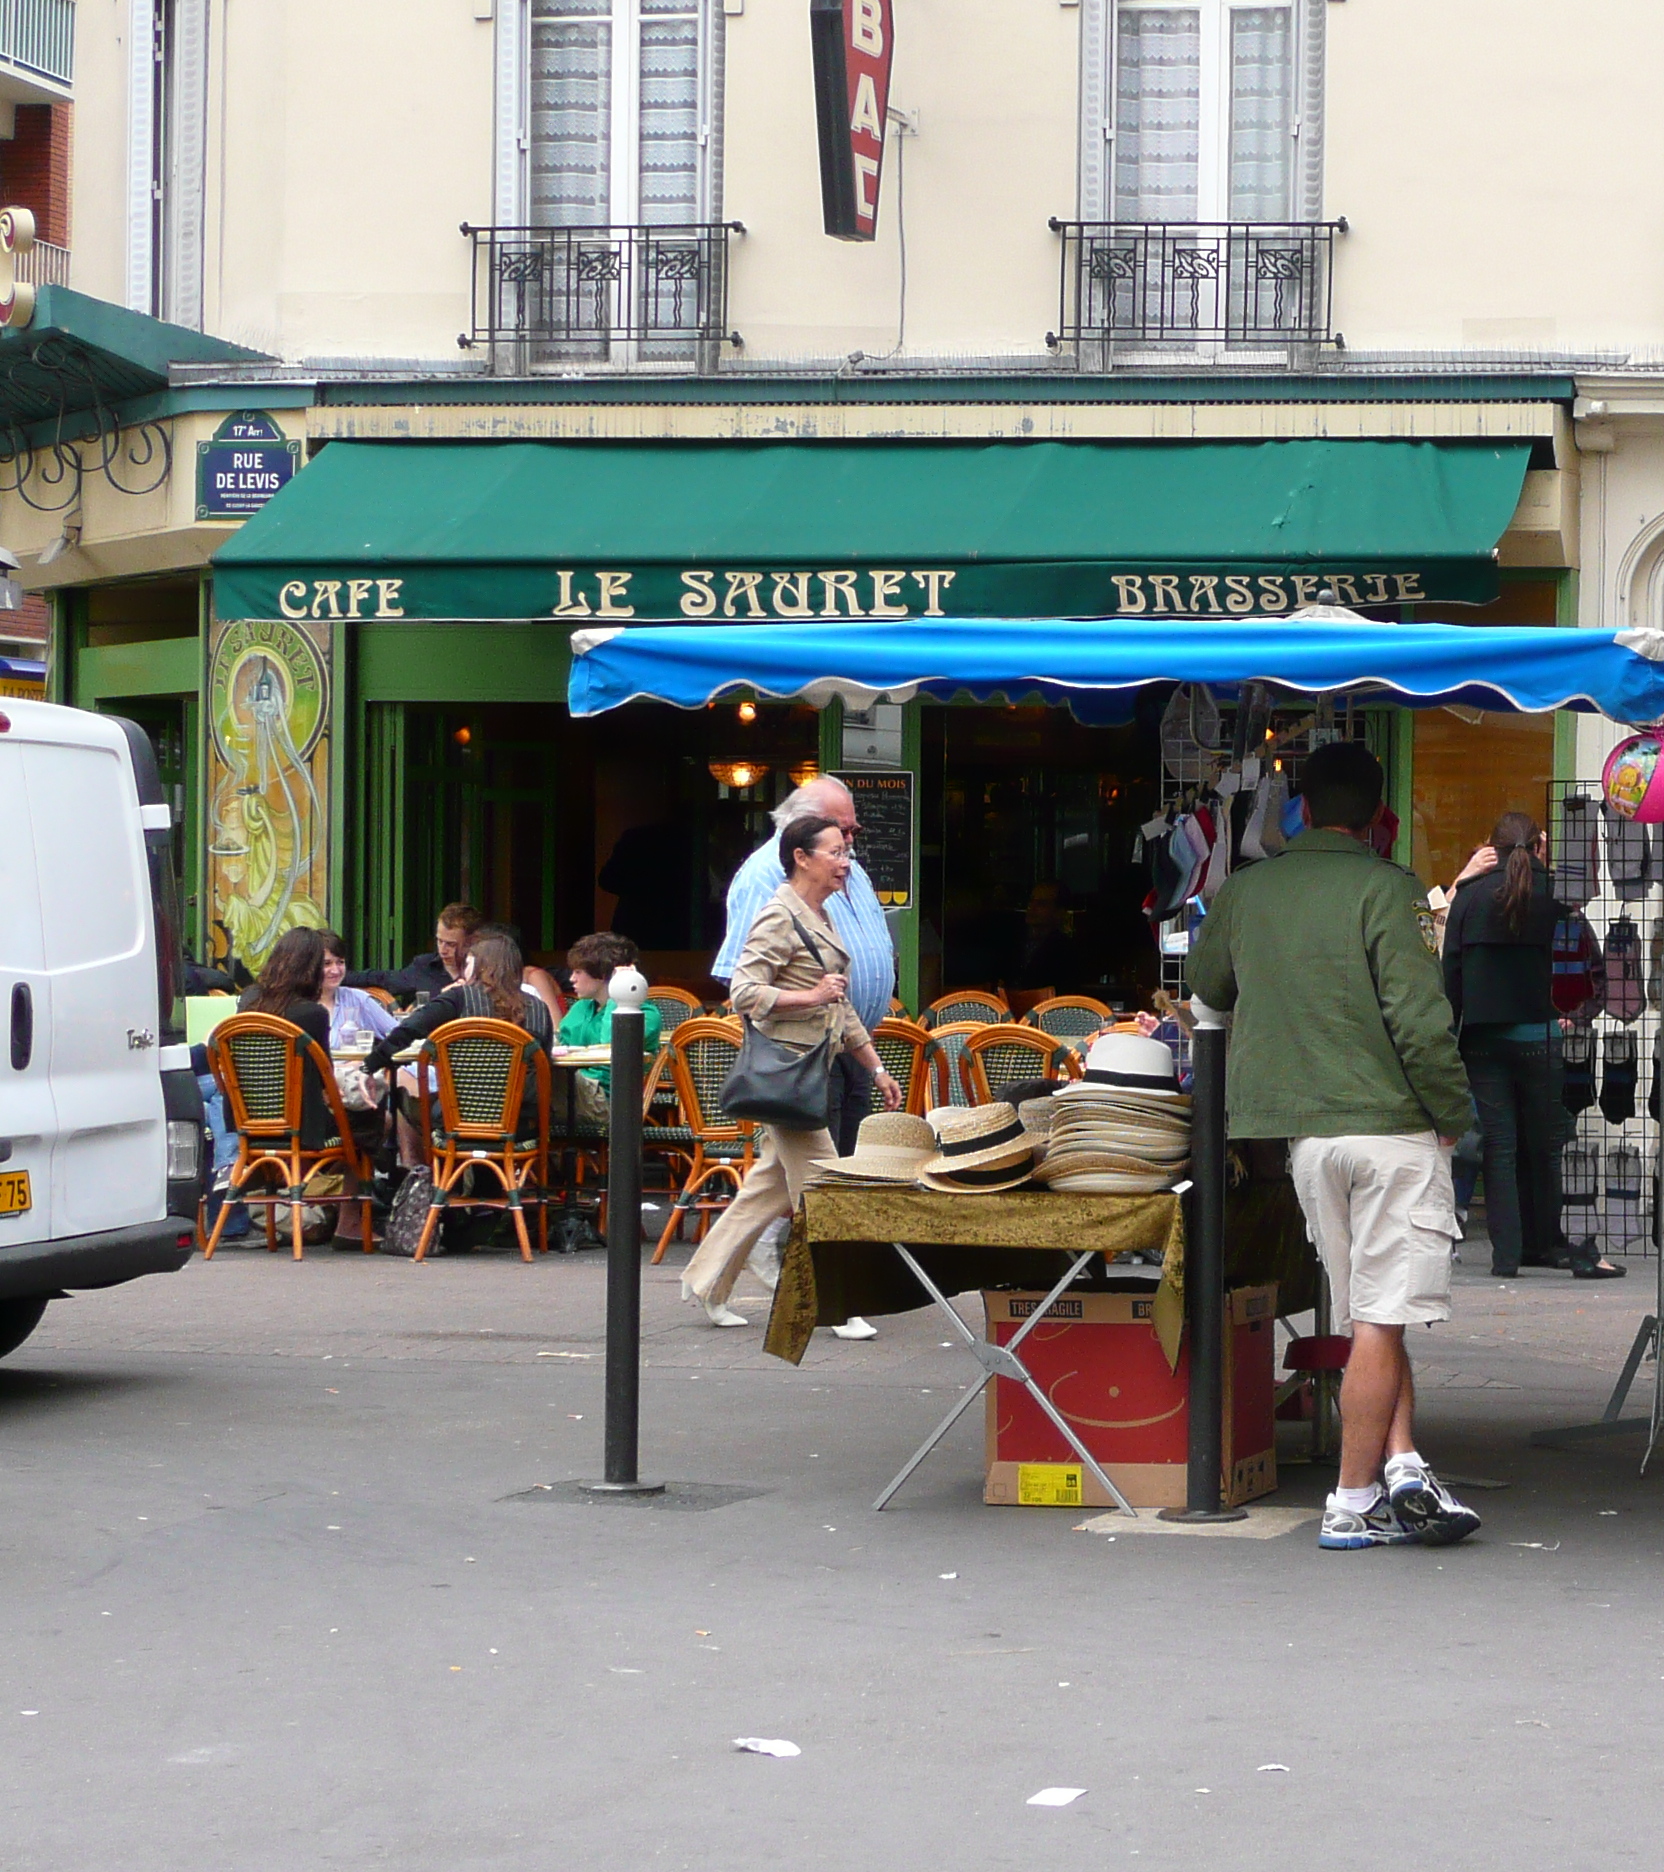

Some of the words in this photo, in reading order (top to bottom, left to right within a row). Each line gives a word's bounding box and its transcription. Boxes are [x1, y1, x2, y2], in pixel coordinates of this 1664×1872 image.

[233, 453, 264, 469] RUE
[216, 473, 235, 489] DE
[239, 473, 280, 489] LEVIS
[279, 578, 406, 619] CAFE
[553, 570, 636, 618] LE
[680, 569, 957, 619] SAURET
[1110, 571, 1427, 612] BRASSERIE
[857, 778, 874, 789] DU
[877, 778, 906, 789] MOIS
[1012, 1301, 1036, 1315] TRES
[1041, 1301, 1081, 1316] AGILE
